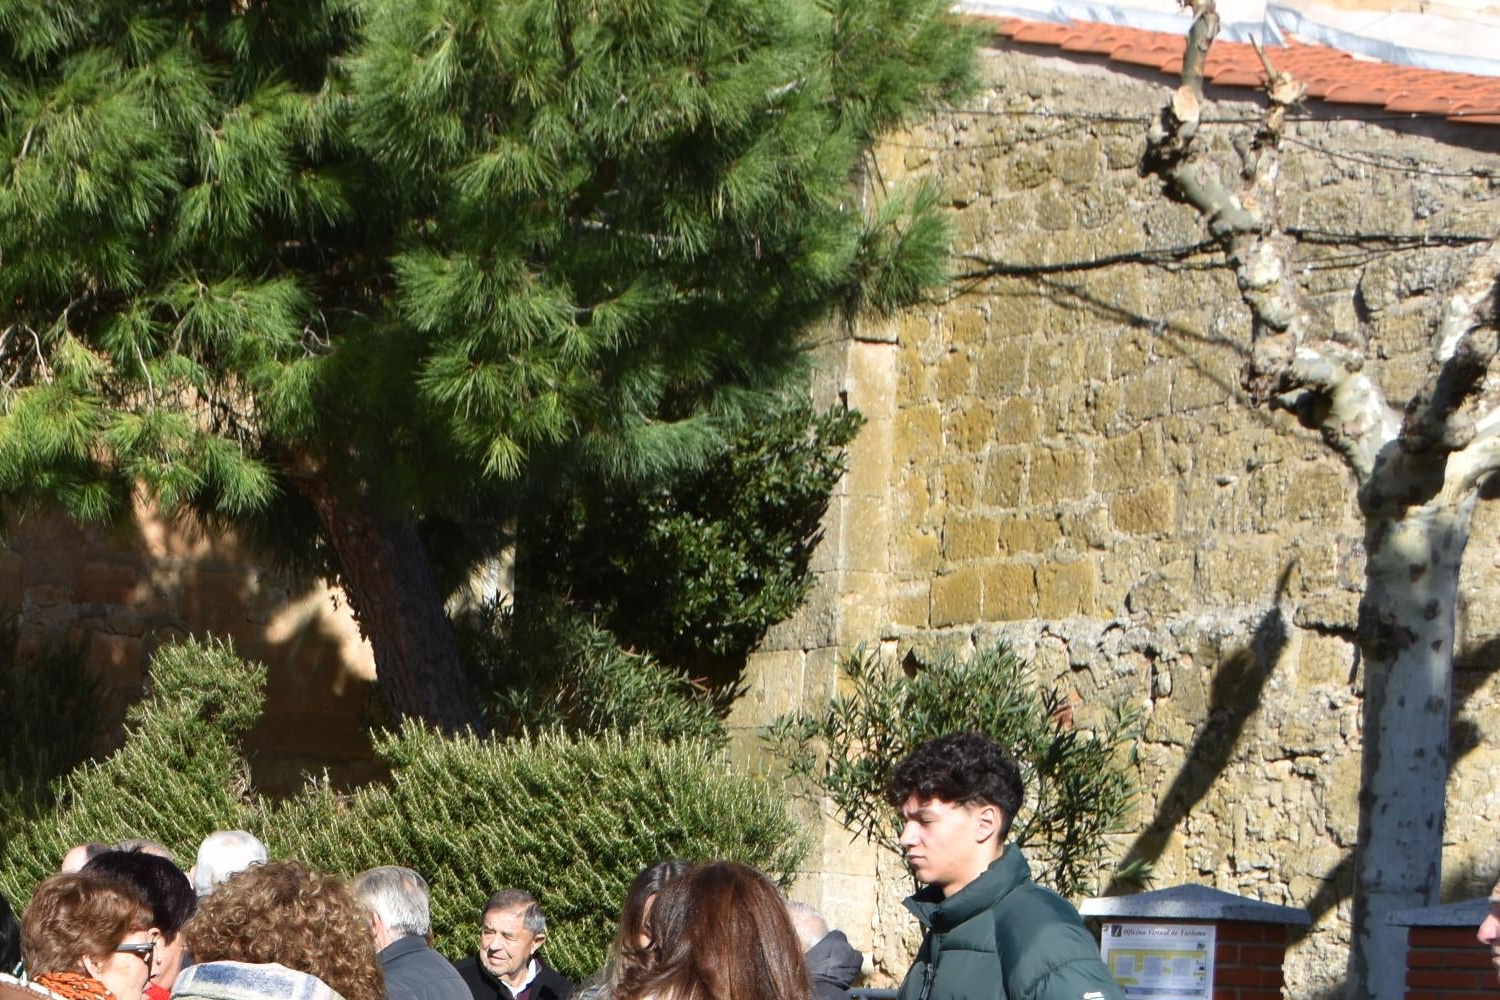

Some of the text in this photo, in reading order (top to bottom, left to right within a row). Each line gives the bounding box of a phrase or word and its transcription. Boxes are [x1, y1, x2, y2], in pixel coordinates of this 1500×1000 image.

[1122, 927, 1207, 937] Oficina Virtual de Turismo
